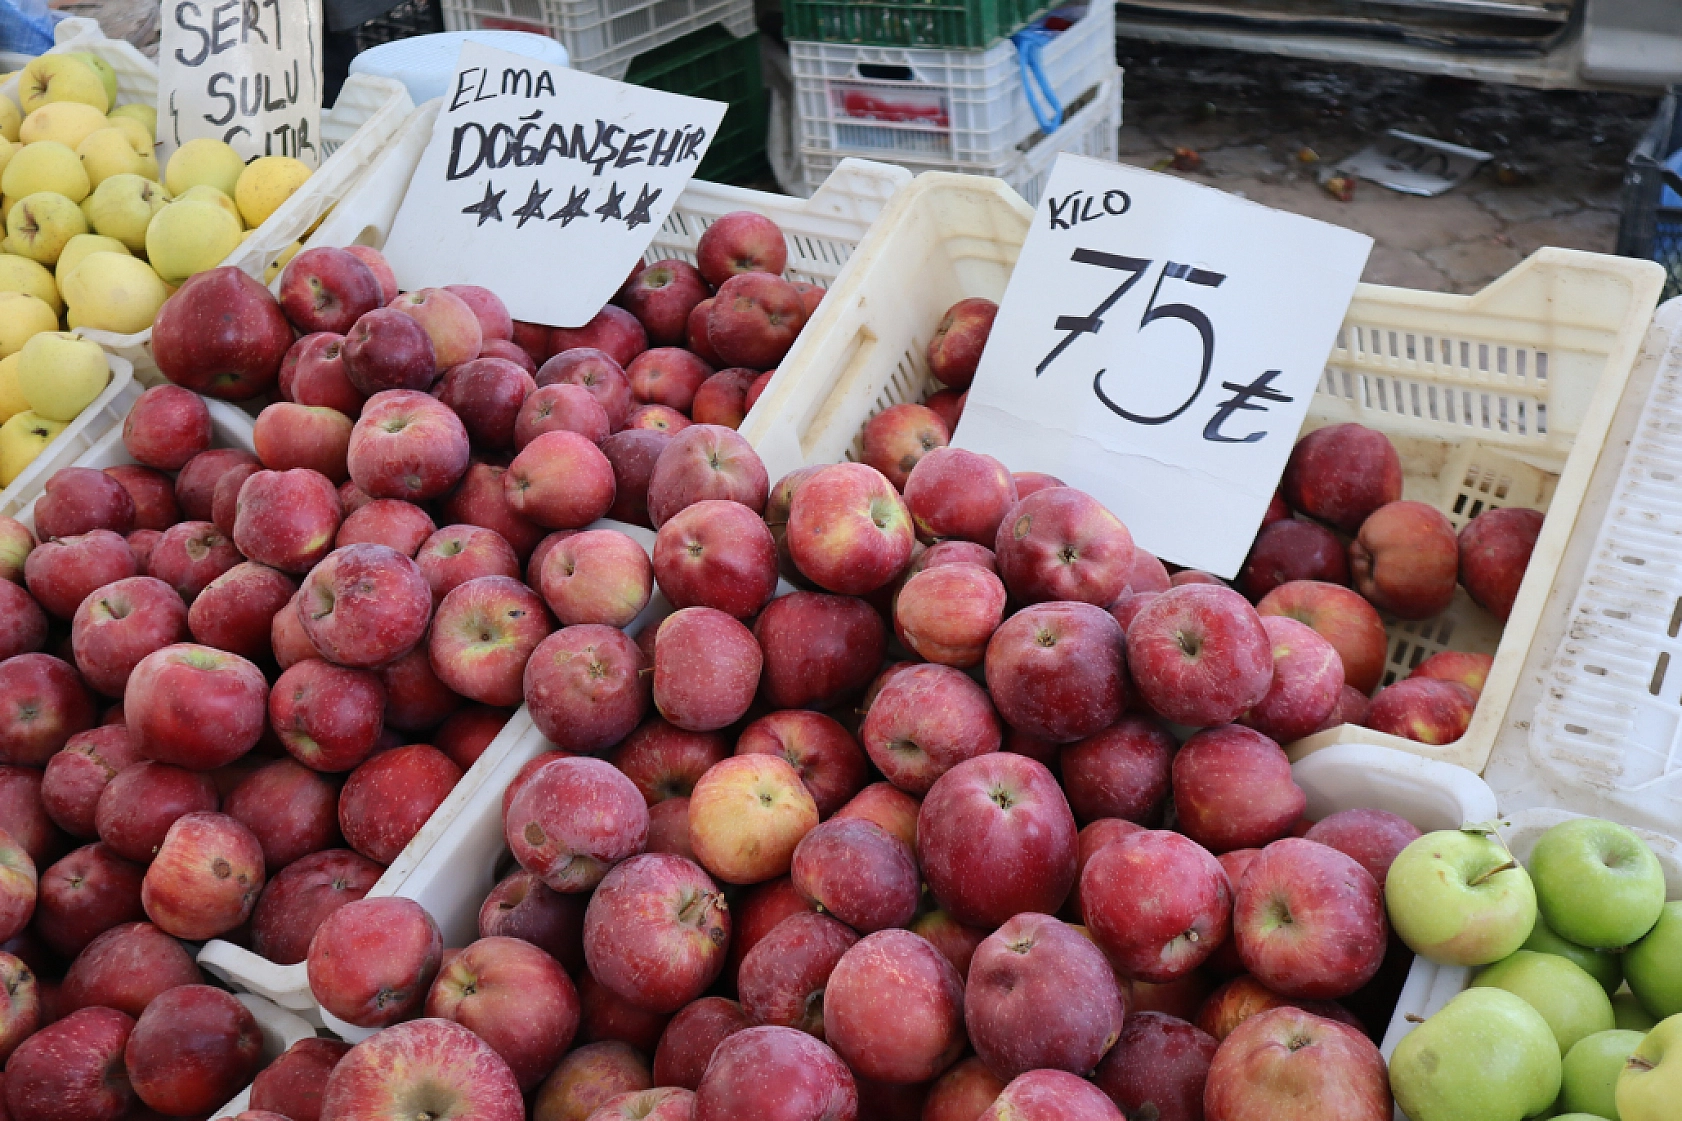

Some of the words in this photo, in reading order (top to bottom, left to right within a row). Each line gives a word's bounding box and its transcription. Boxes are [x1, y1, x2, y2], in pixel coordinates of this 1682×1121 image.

[175, 0, 281, 67] SERT
[204, 59, 299, 125] SULU
[448, 67, 555, 113] ELMA
